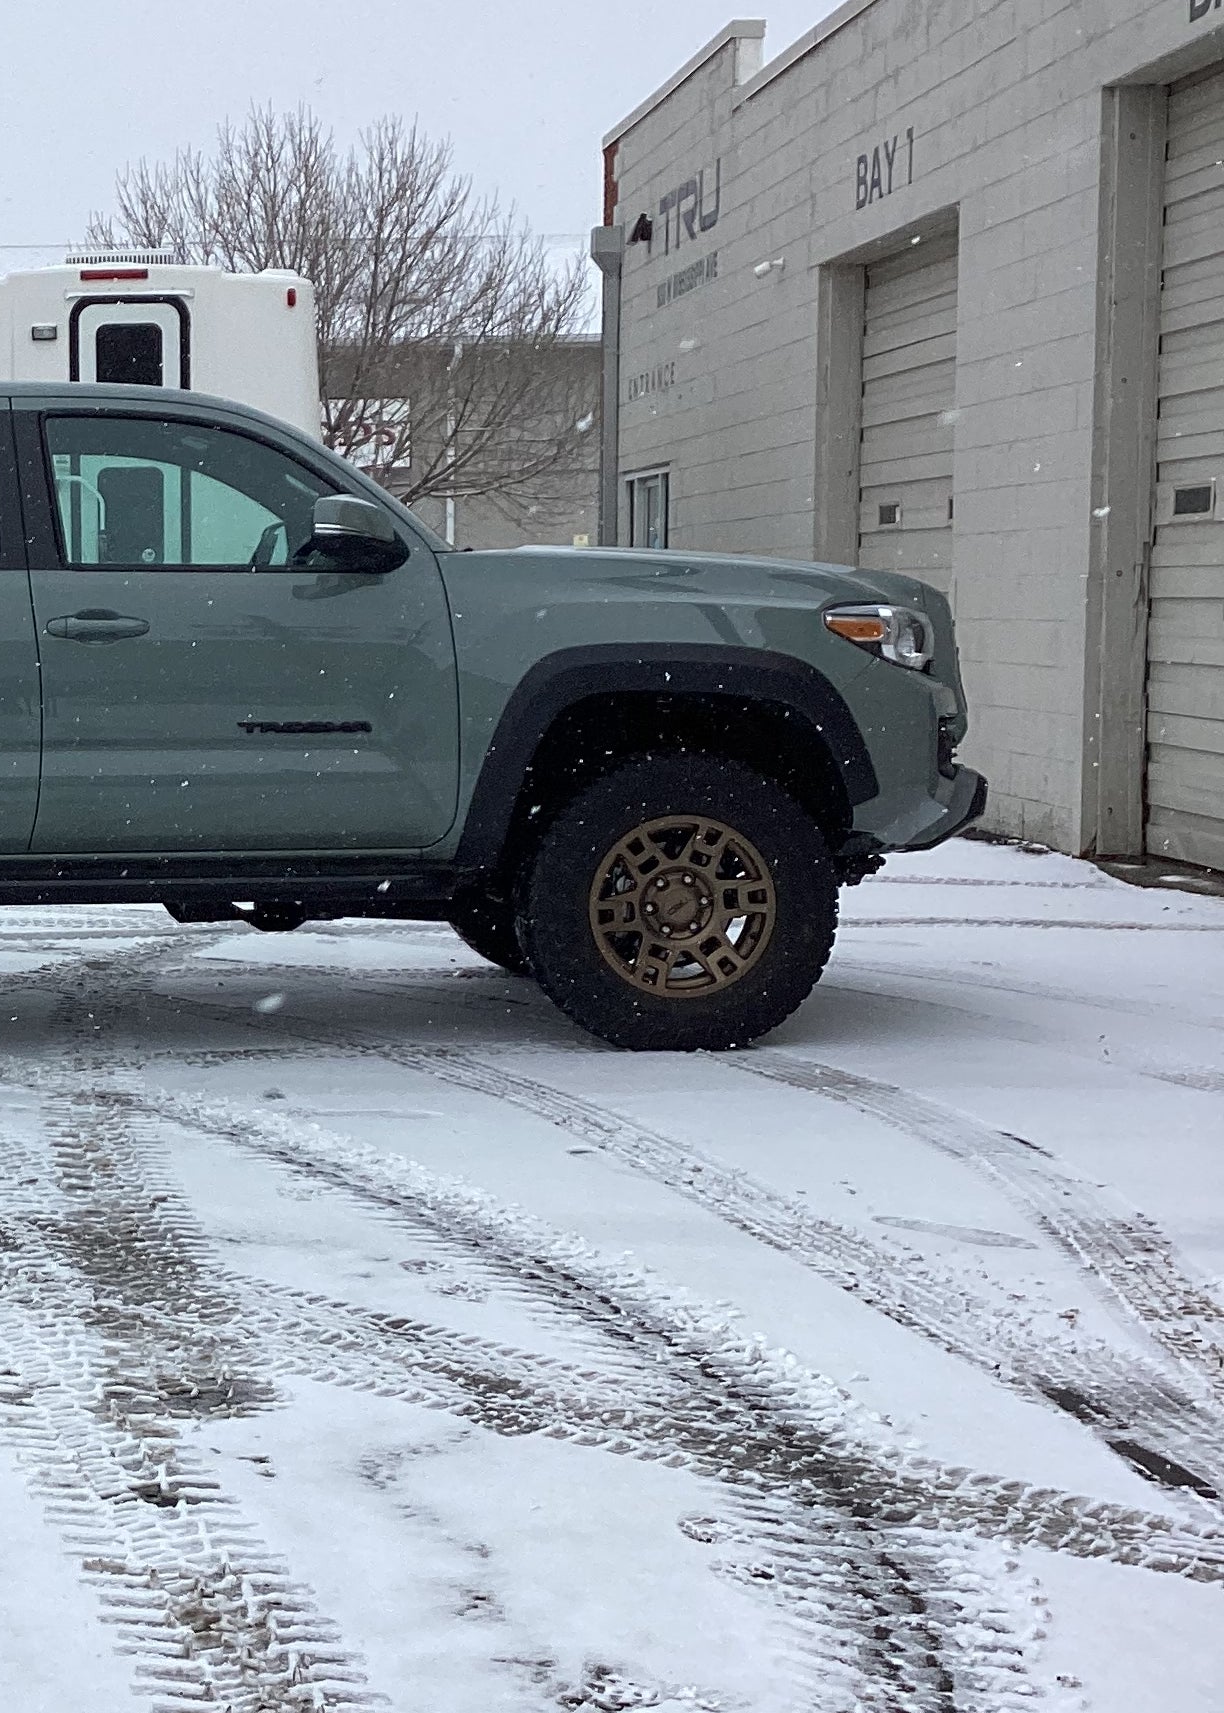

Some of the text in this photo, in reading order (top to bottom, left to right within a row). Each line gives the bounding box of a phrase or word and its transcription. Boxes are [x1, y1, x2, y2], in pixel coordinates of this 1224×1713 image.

[659, 157, 721, 257] TRU
[855, 126, 915, 211] BAY 1
